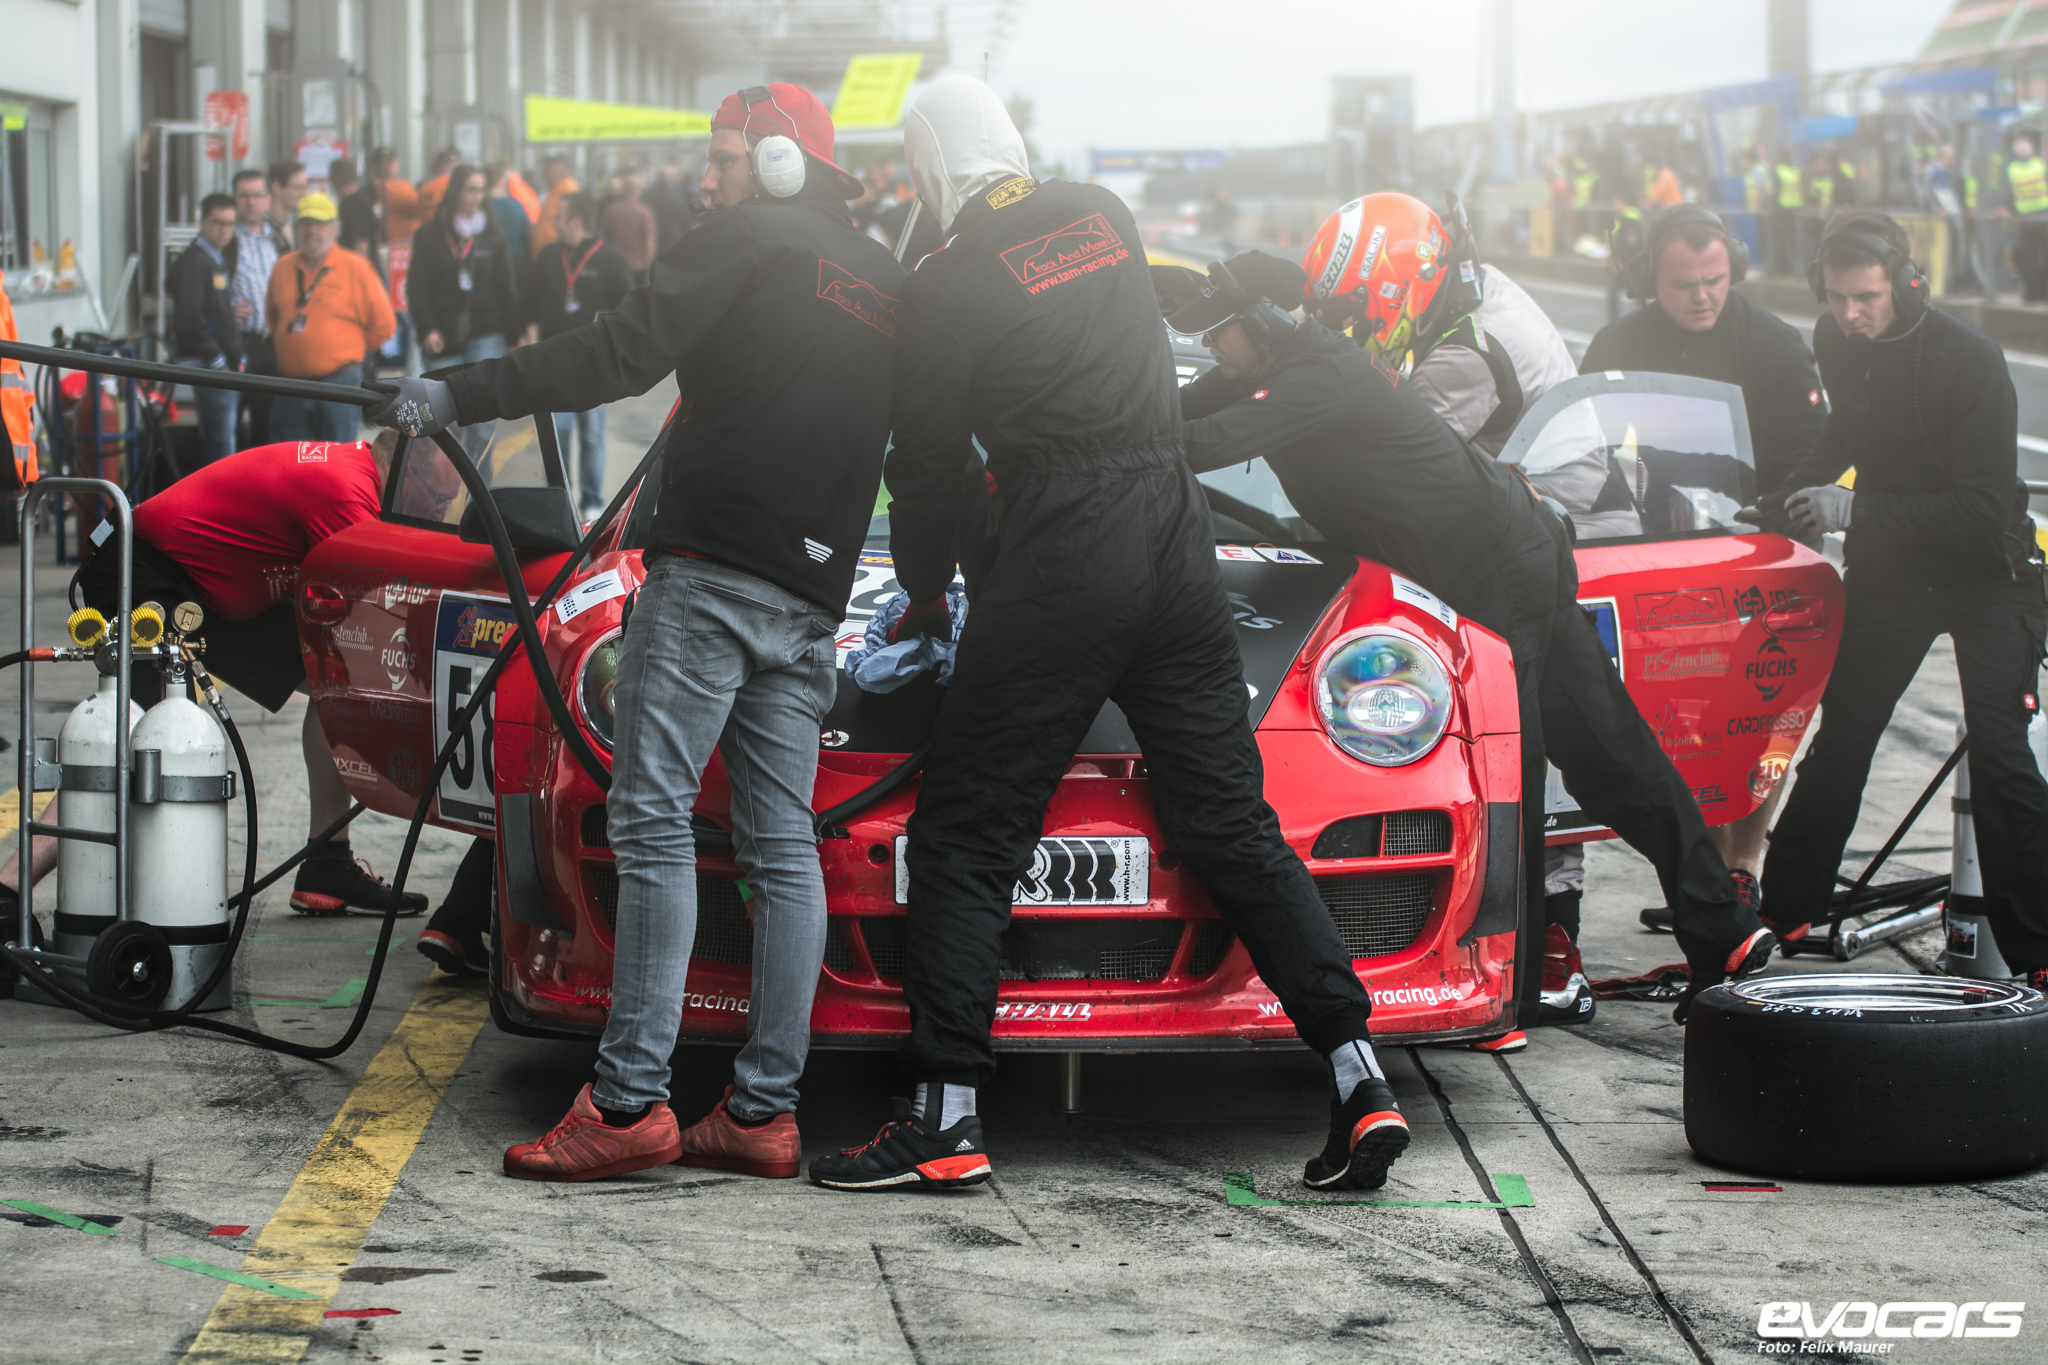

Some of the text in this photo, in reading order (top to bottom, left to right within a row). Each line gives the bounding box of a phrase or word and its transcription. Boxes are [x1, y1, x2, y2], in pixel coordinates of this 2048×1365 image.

[990, 190, 1008, 206] FIA
[1095, 217, 1116, 243] RACING
[1027, 240, 1107, 274] Track And More
[1316, 233, 1353, 298] SCHALL
[1027, 247, 1129, 295] www.tam-racing.de
[834, 285, 852, 308] Track
[854, 300, 871, 320] And
[1394, 279, 1411, 310] uvex
[1652, 608, 1713, 623] Track And More
[381, 648, 416, 669] FUCHS
[1745, 658, 1797, 680] FUCHS
[1727, 711, 1805, 735] CARDPRESSO
[1665, 732, 1722, 747] frenken &co.
[1123, 840, 1131, 901] www.h-r.com
[926, 1163, 944, 1179] boost
